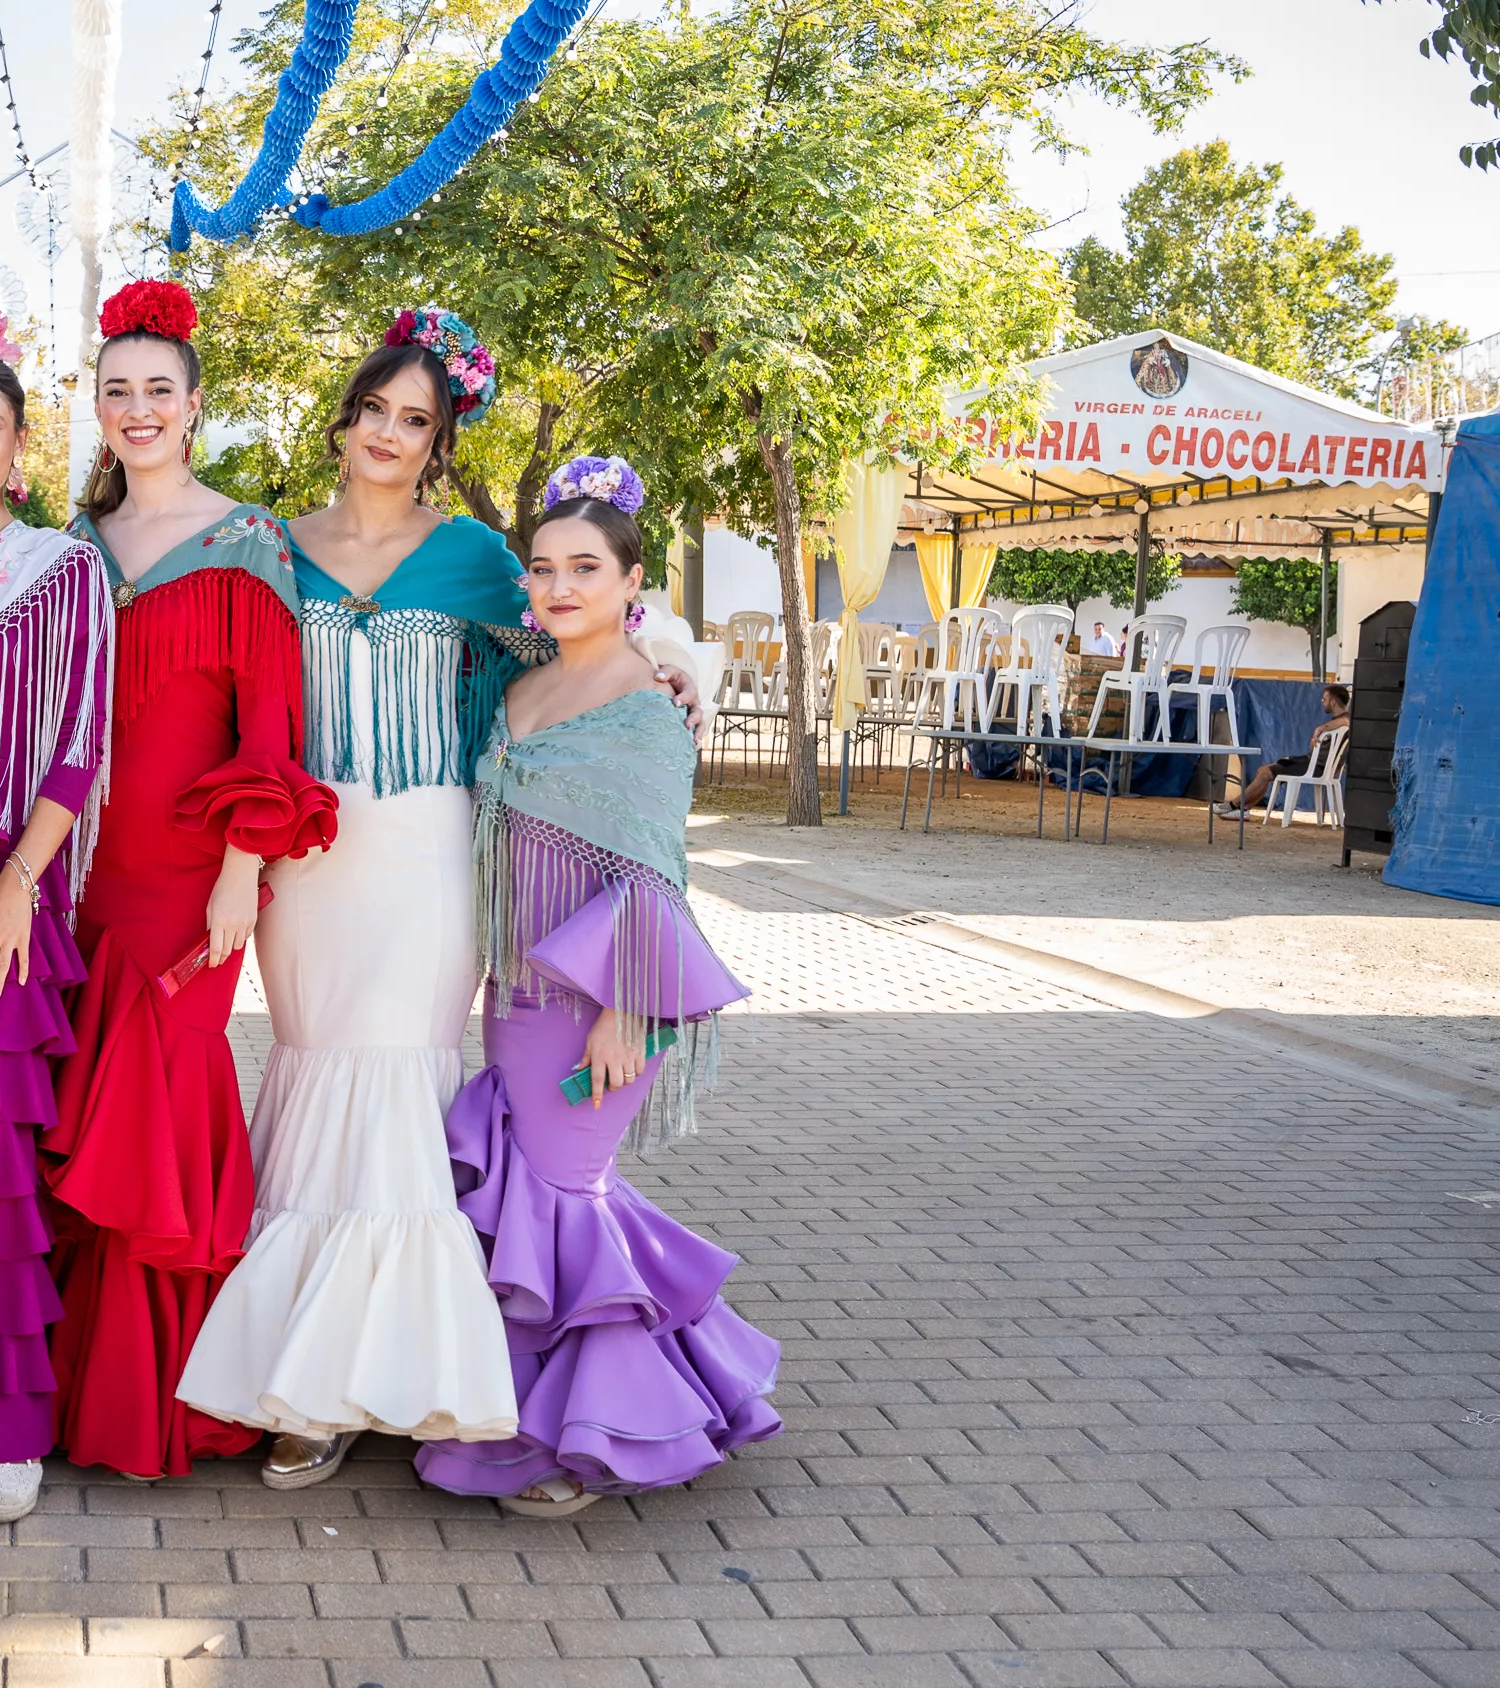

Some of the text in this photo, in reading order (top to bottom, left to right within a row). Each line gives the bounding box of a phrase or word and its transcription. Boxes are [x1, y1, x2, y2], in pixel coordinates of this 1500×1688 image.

[1074, 401, 1262, 422] VIRGEN DE ARACELI
[1146, 424, 1427, 480] CHOCOLATERIA
